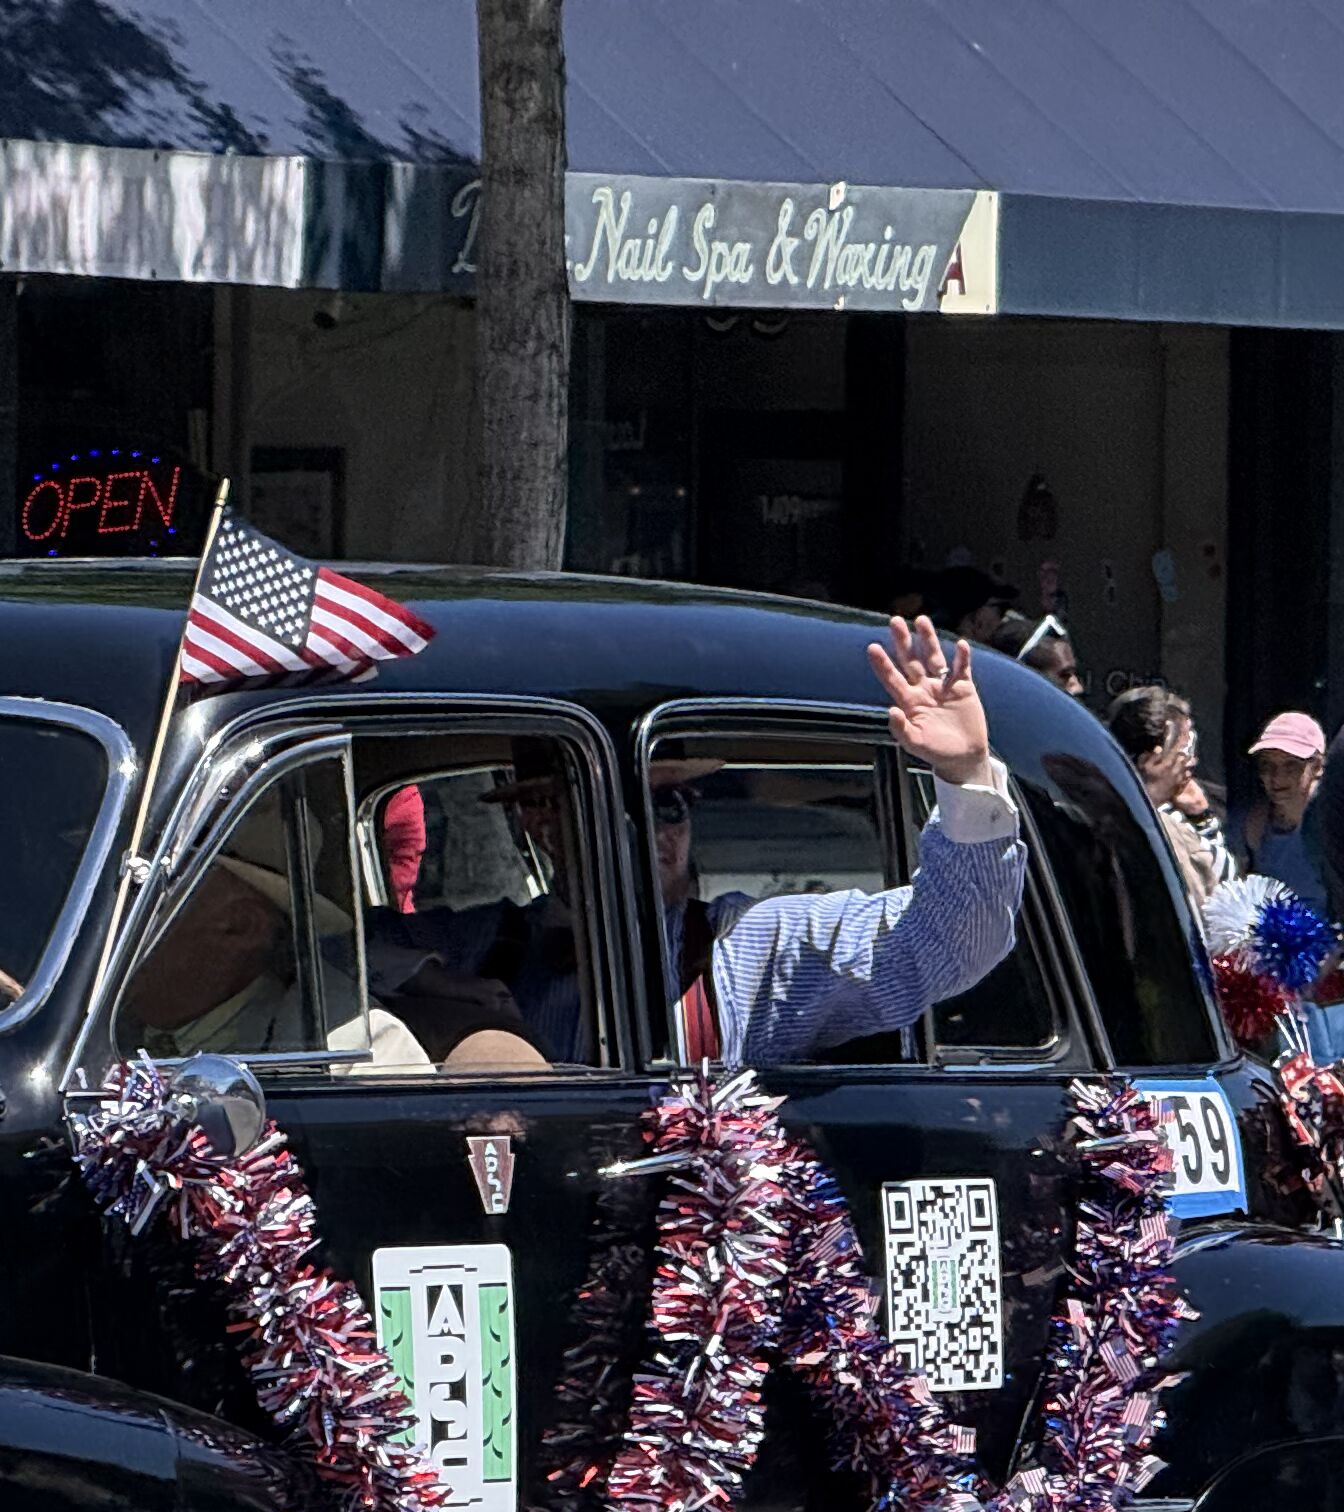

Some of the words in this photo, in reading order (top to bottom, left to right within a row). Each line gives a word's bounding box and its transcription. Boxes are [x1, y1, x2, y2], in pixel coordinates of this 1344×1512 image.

[575, 186, 678, 282] Nail
[683, 203, 754, 299] Spa
[766, 197, 799, 285] &
[804, 205, 938, 311] Waxing
[21, 466, 180, 540] OPEN
[1155, 1095, 1230, 1190] 59
